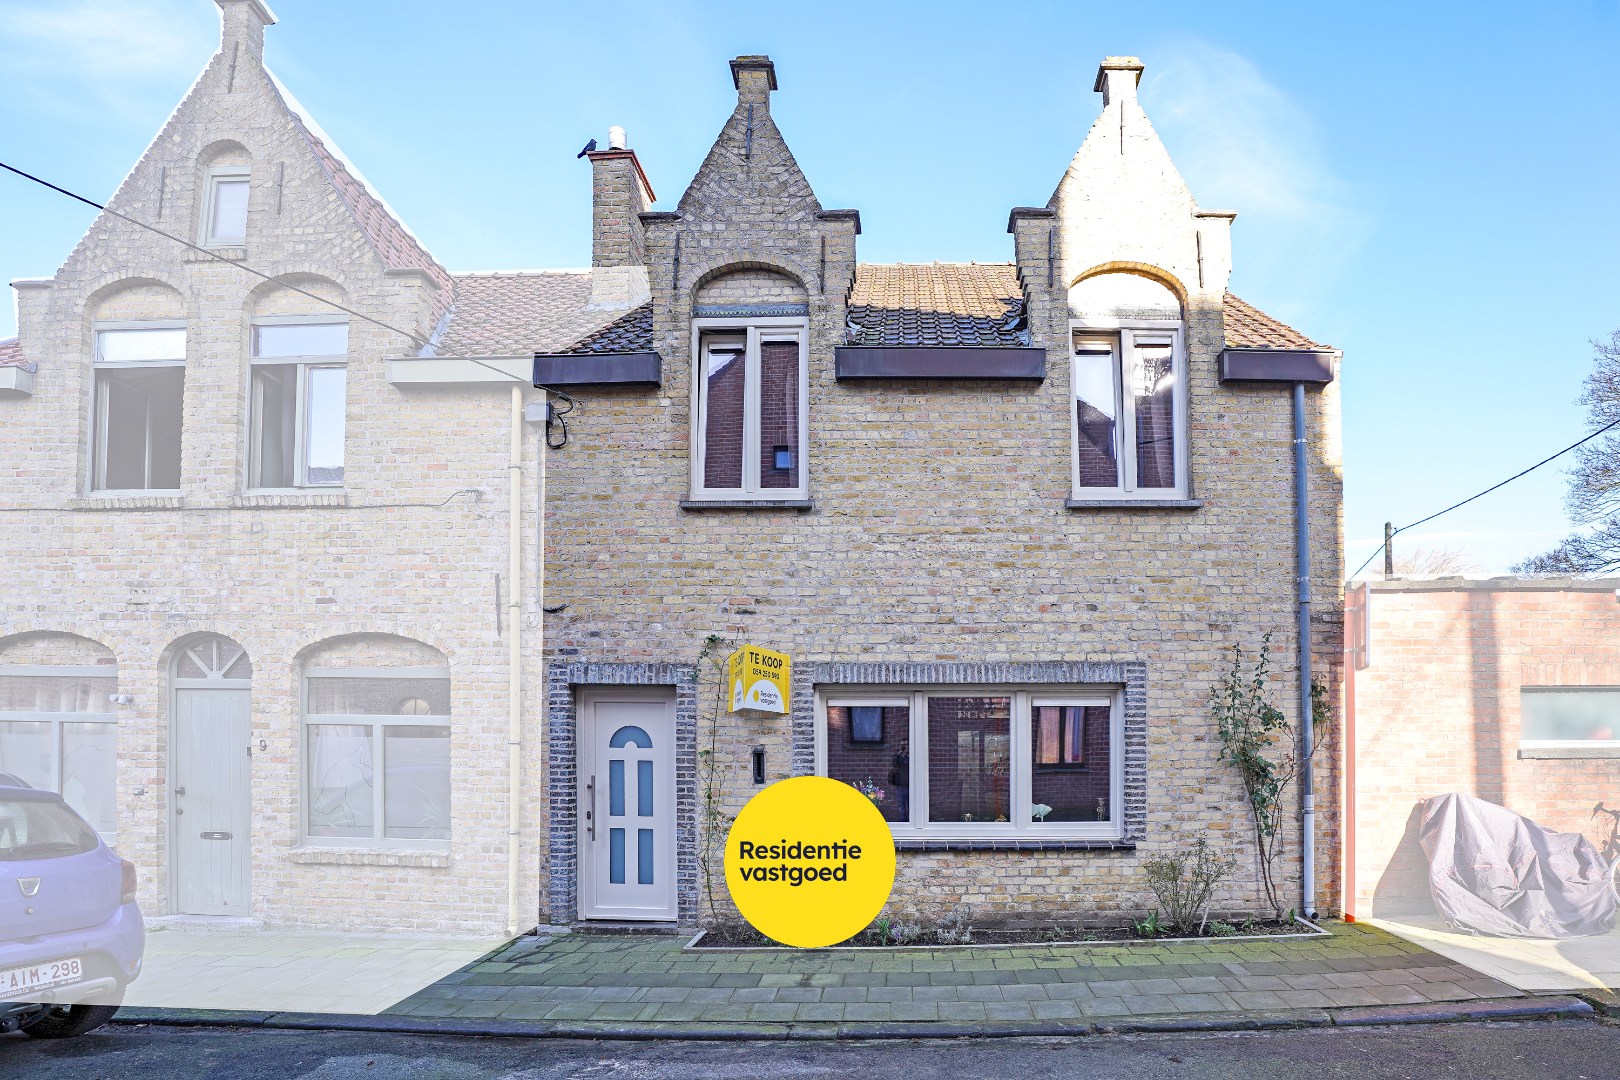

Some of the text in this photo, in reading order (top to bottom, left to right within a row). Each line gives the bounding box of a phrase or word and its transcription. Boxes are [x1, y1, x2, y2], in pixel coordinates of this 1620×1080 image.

[749, 651, 760, 665] TE
[762, 654, 783, 670] KOOP
[259, 739, 267, 751] 9
